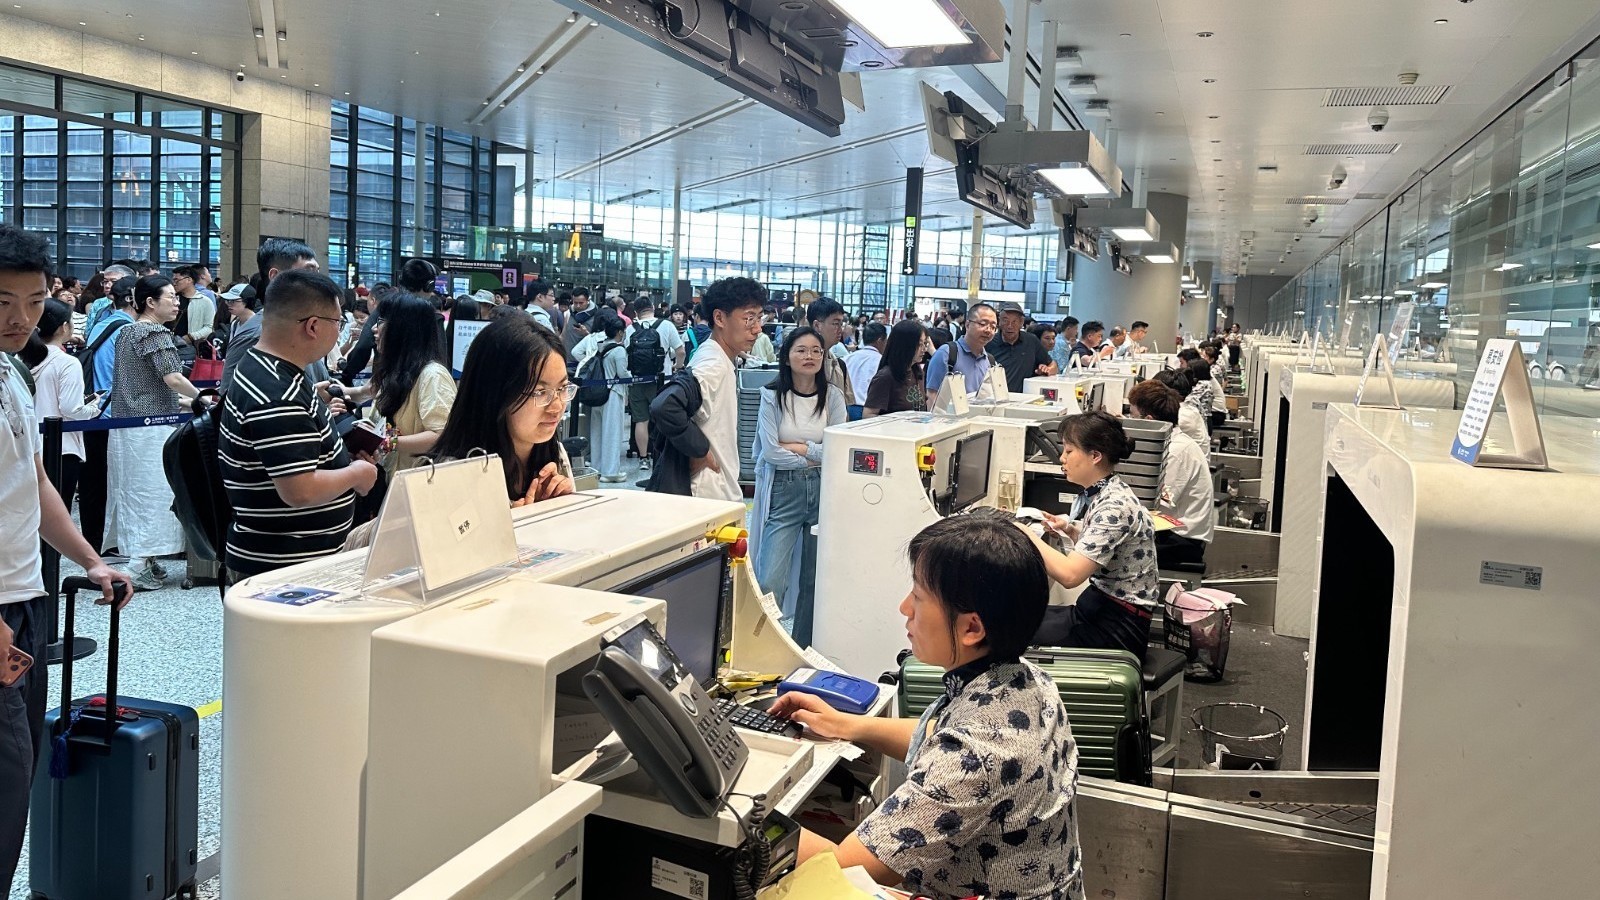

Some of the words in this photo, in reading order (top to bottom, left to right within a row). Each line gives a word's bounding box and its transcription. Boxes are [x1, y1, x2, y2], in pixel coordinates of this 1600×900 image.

[567, 232, 580, 258] A
[905, 227, 915, 248] 出发
[782, 292, 788, 301] 3
